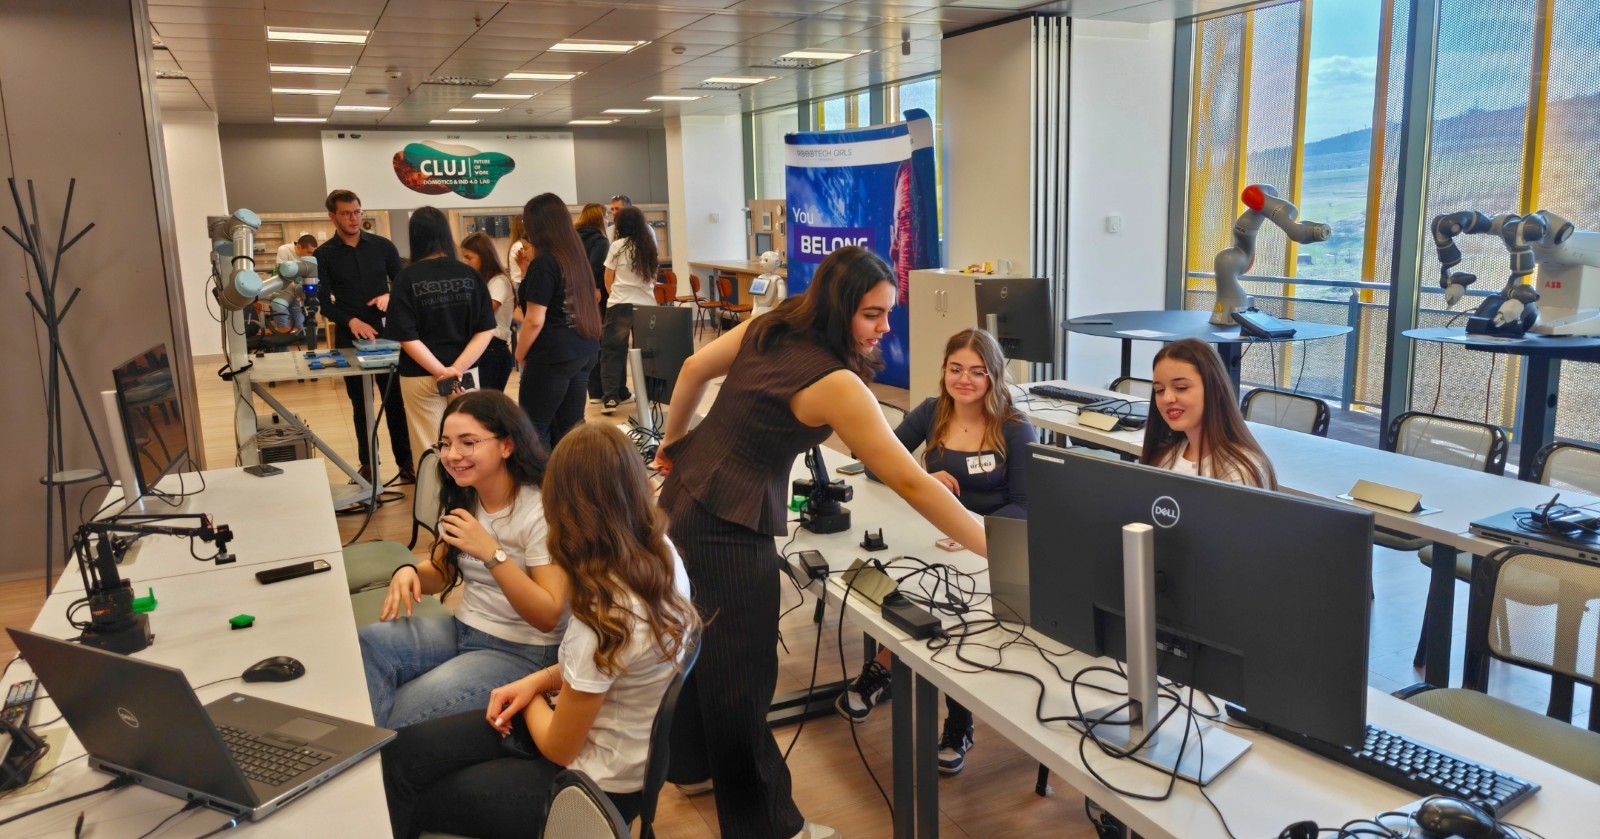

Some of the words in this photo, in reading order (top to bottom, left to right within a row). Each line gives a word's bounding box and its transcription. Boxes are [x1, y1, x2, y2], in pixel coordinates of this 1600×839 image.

[420, 160, 466, 176] CLUJ
[792, 206, 814, 225] You
[412, 278, 474, 296] Kappa
[1155, 505, 1177, 518] DELL
